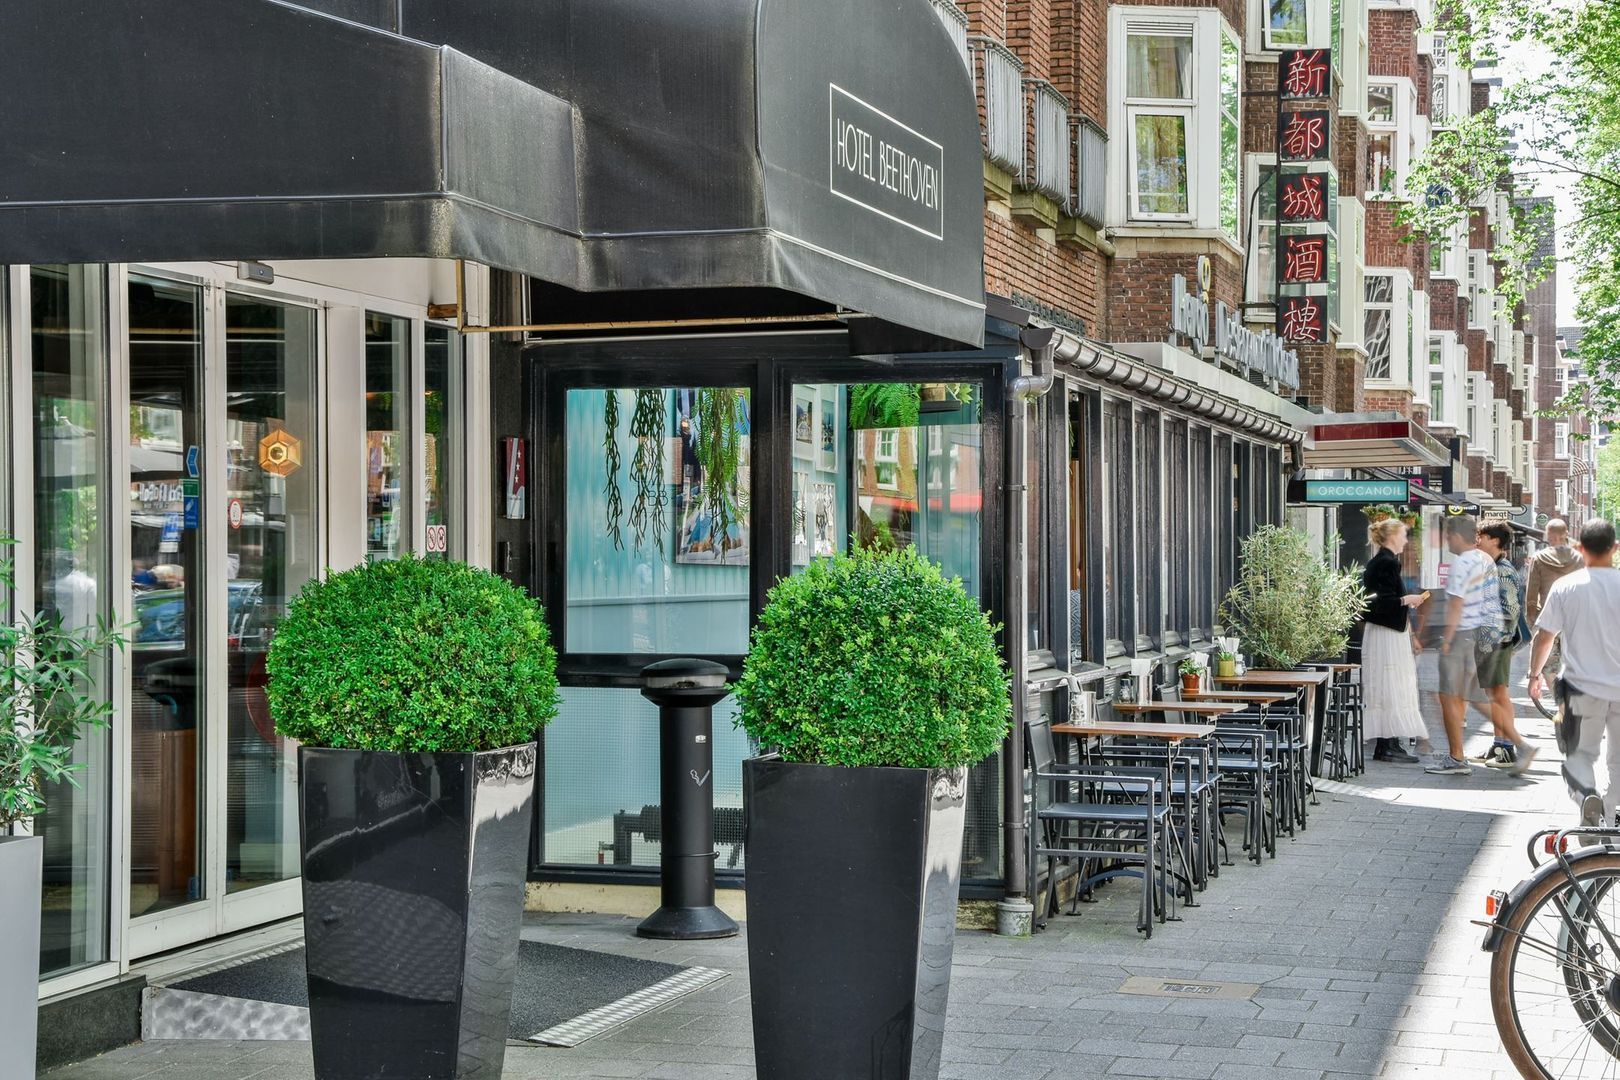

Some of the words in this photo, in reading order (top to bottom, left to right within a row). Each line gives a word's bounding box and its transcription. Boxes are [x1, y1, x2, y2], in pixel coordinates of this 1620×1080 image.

[837, 118, 876, 182] HOTEL
[879, 140, 939, 211] BEETHOVEN
[1284, 49, 1327, 340] 新都城酒樓
[1309, 486, 1405, 496] OROCCANOIL
